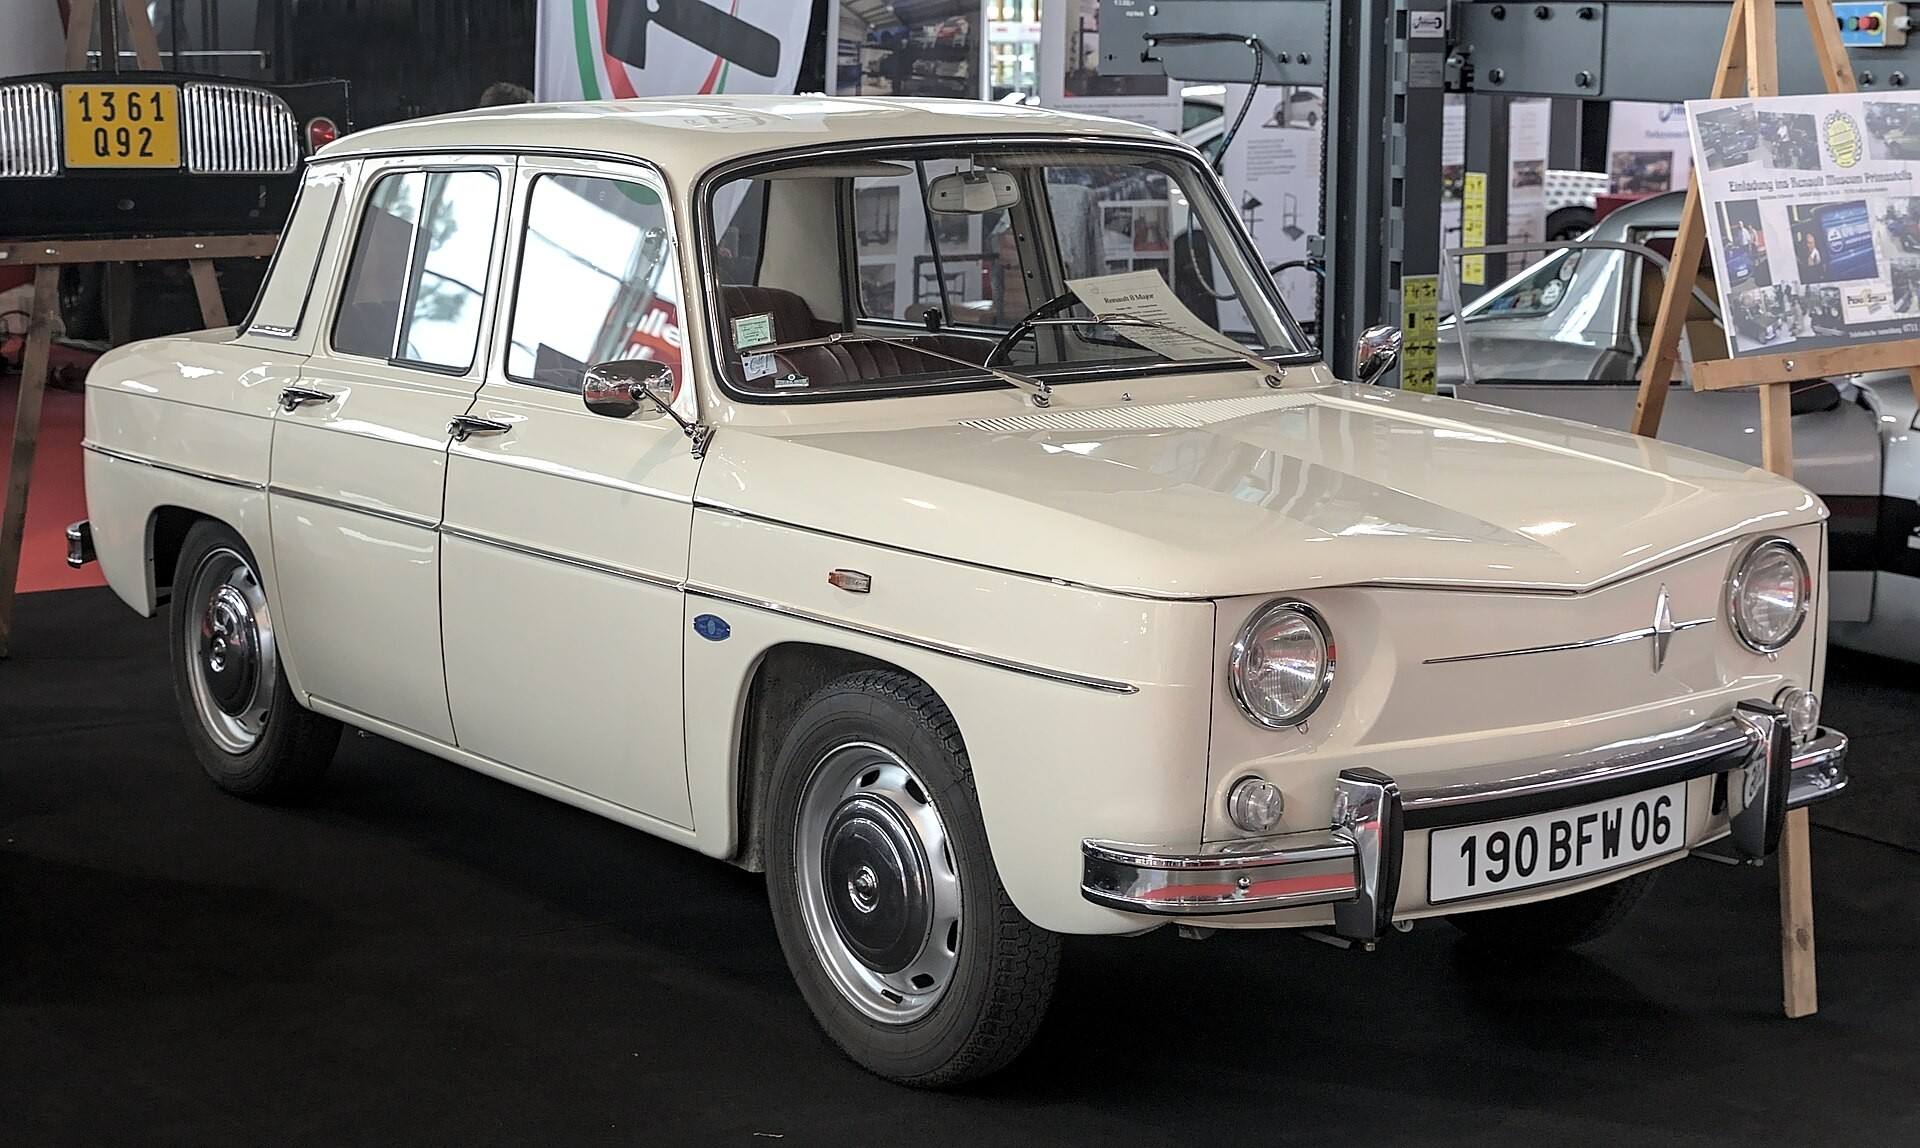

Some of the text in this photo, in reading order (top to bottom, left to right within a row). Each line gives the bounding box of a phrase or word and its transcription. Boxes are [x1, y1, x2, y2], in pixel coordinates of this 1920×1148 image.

[78, 91, 165, 122] 1361
[94, 126, 154, 157] Q92
[1104, 296, 1129, 304] Renault
[1460, 795, 1672, 887] 190 BFW 06
